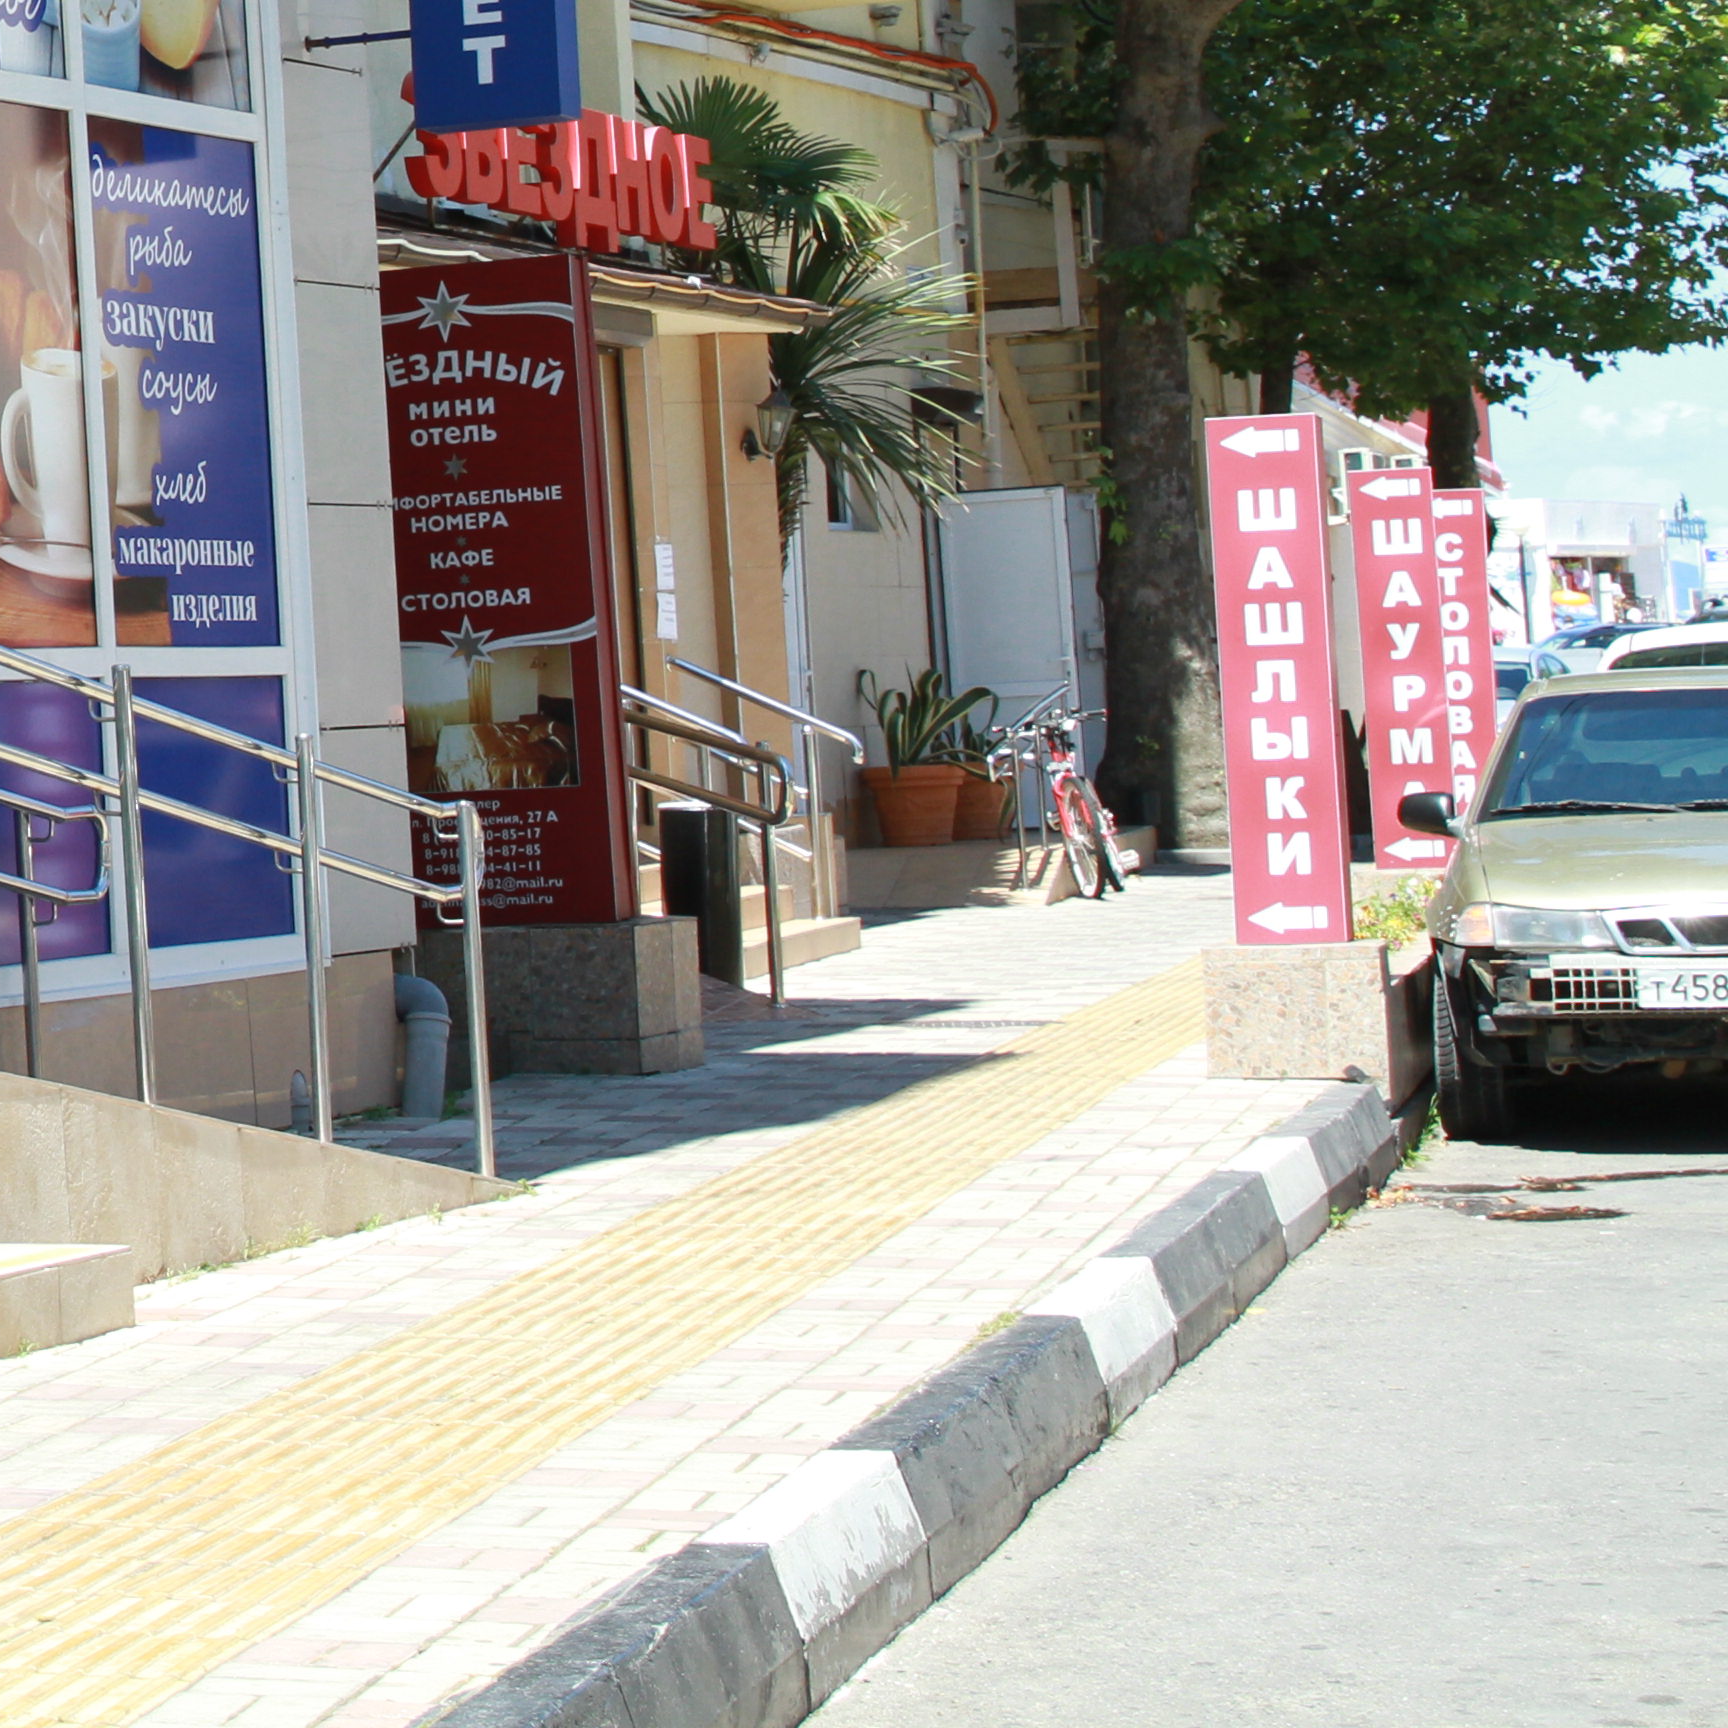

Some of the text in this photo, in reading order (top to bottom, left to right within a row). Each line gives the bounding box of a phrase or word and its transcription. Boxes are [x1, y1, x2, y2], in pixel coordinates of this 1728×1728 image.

[91, 153, 250, 218] деликатесы
[129, 225, 193, 276] рыба
[106, 298, 216, 352] закуски
[141, 367, 218, 416] соусы
[385, 349, 566, 397] ЁЗДНЫЙ
[155, 460, 208, 506] хлеб
[396, 484, 563, 511] ФОРТАБЕЛЬНЫЕ
[410, 510, 510, 534] НОМЕРА
[118, 535, 255, 575] макаронные
[429, 548, 495, 570] КАФЕ
[172, 593, 258, 628] изделия
[400, 587, 532, 613] СТОЛОВАЯ
[1236, 486, 1313, 876] ШАШЛЫКИ
[527, 811, 542, 823] 27
